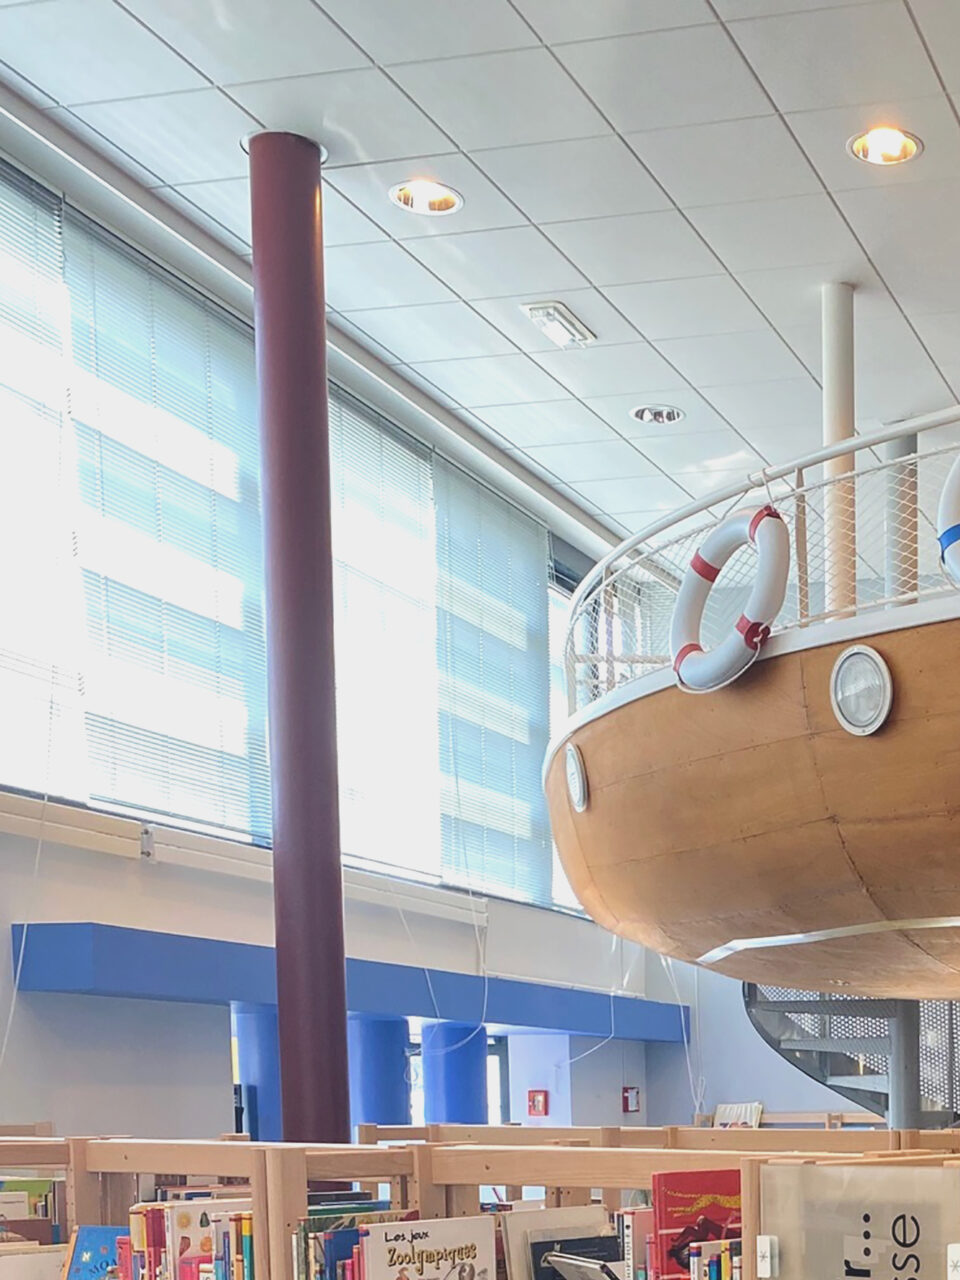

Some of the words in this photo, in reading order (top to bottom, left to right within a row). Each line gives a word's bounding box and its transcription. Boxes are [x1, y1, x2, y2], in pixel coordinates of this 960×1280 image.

[384, 1231, 405, 1242] Les
[407, 1229, 430, 1244] jeux
[387, 1243, 478, 1276] Zoolympiques
